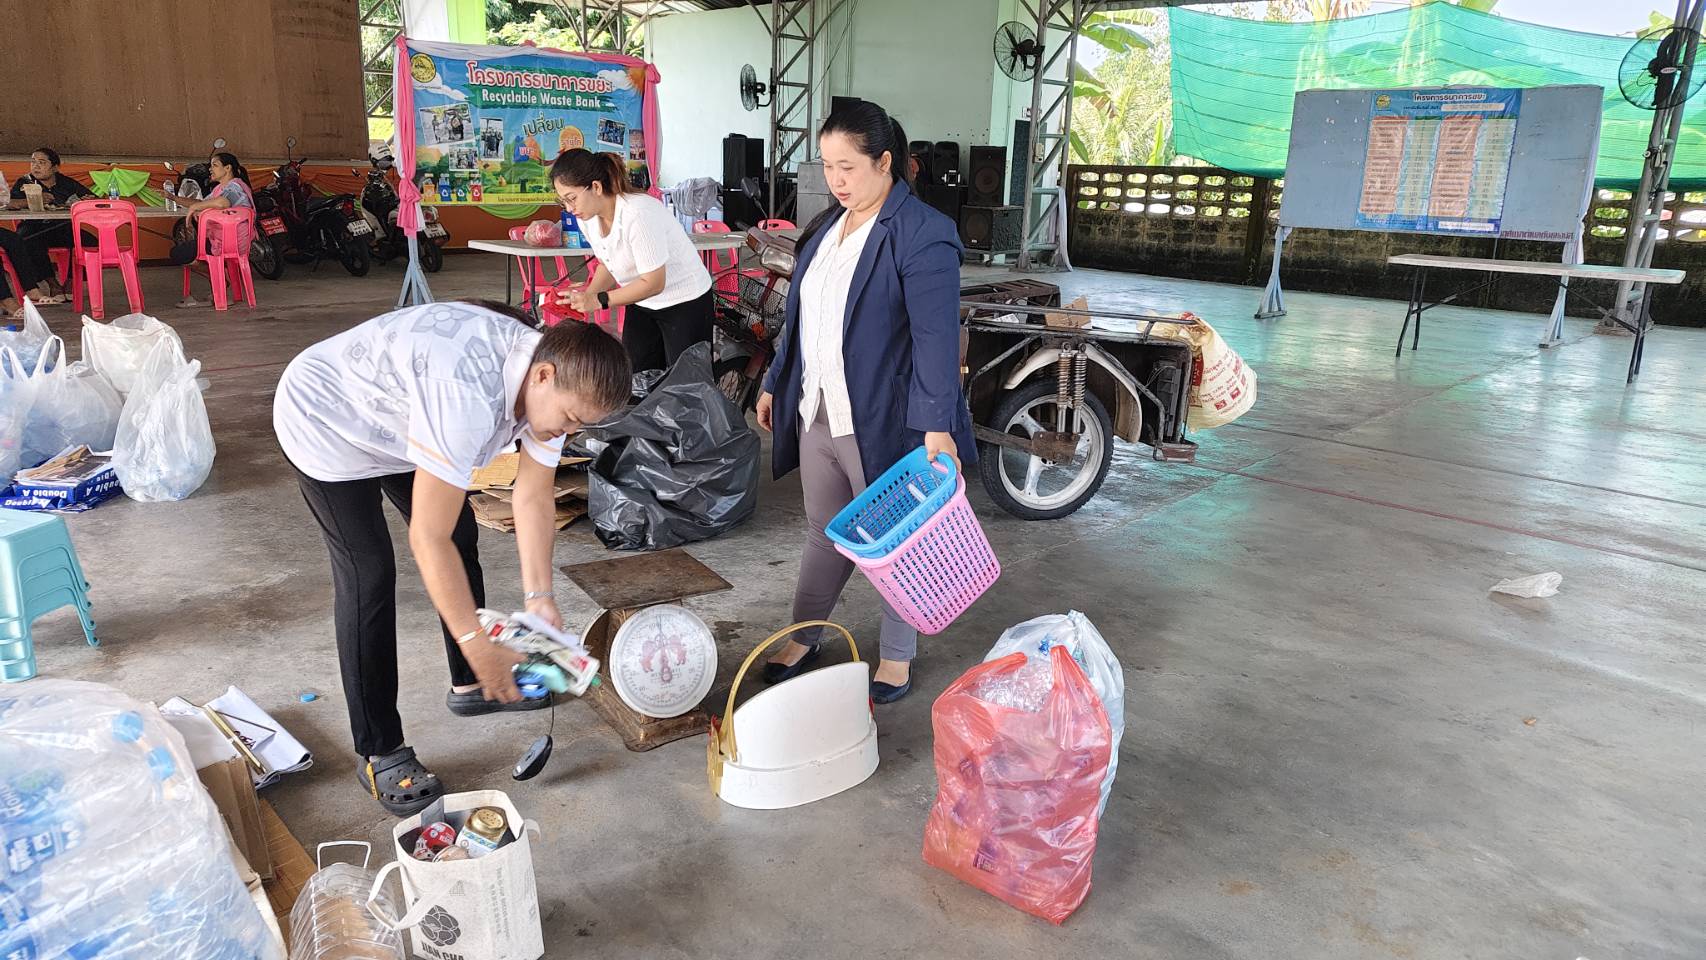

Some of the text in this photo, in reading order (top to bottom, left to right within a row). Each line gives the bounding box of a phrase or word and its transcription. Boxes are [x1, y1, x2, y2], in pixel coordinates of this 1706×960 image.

[466, 60, 613, 92] โครงการธนาคารขยะ
[482, 88, 601, 107] Recyclable Waste Bank
[22, 489, 67, 499] Double A
